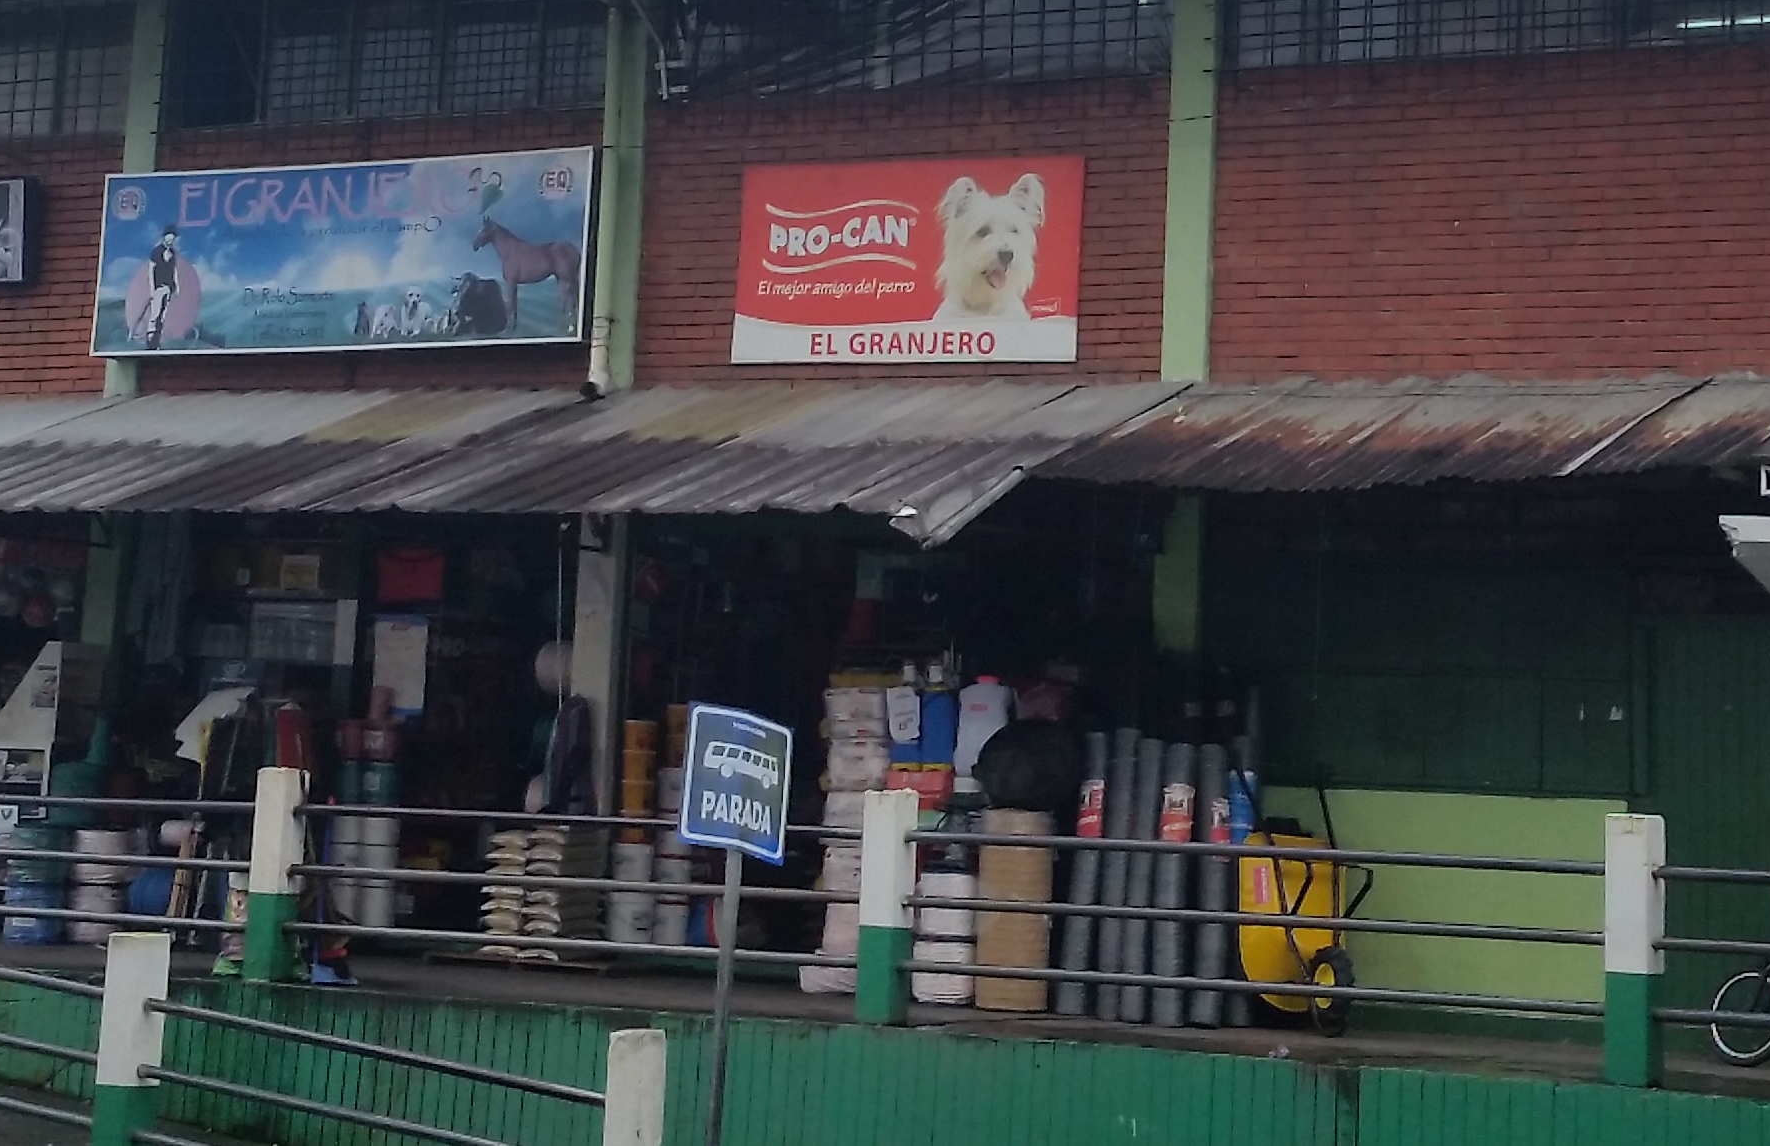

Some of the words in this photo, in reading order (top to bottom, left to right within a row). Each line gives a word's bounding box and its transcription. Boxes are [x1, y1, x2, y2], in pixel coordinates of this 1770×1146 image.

[768, 214, 909, 257] PRO-CAN
[772, 281, 812, 300] mejor
[812, 280, 852, 299] amigo
[855, 277, 876, 295] del
[875, 280, 916, 299] perro
[810, 333, 838, 355] EL
[849, 331, 997, 355] GRANJERO
[701, 790, 771, 836] PARADA
